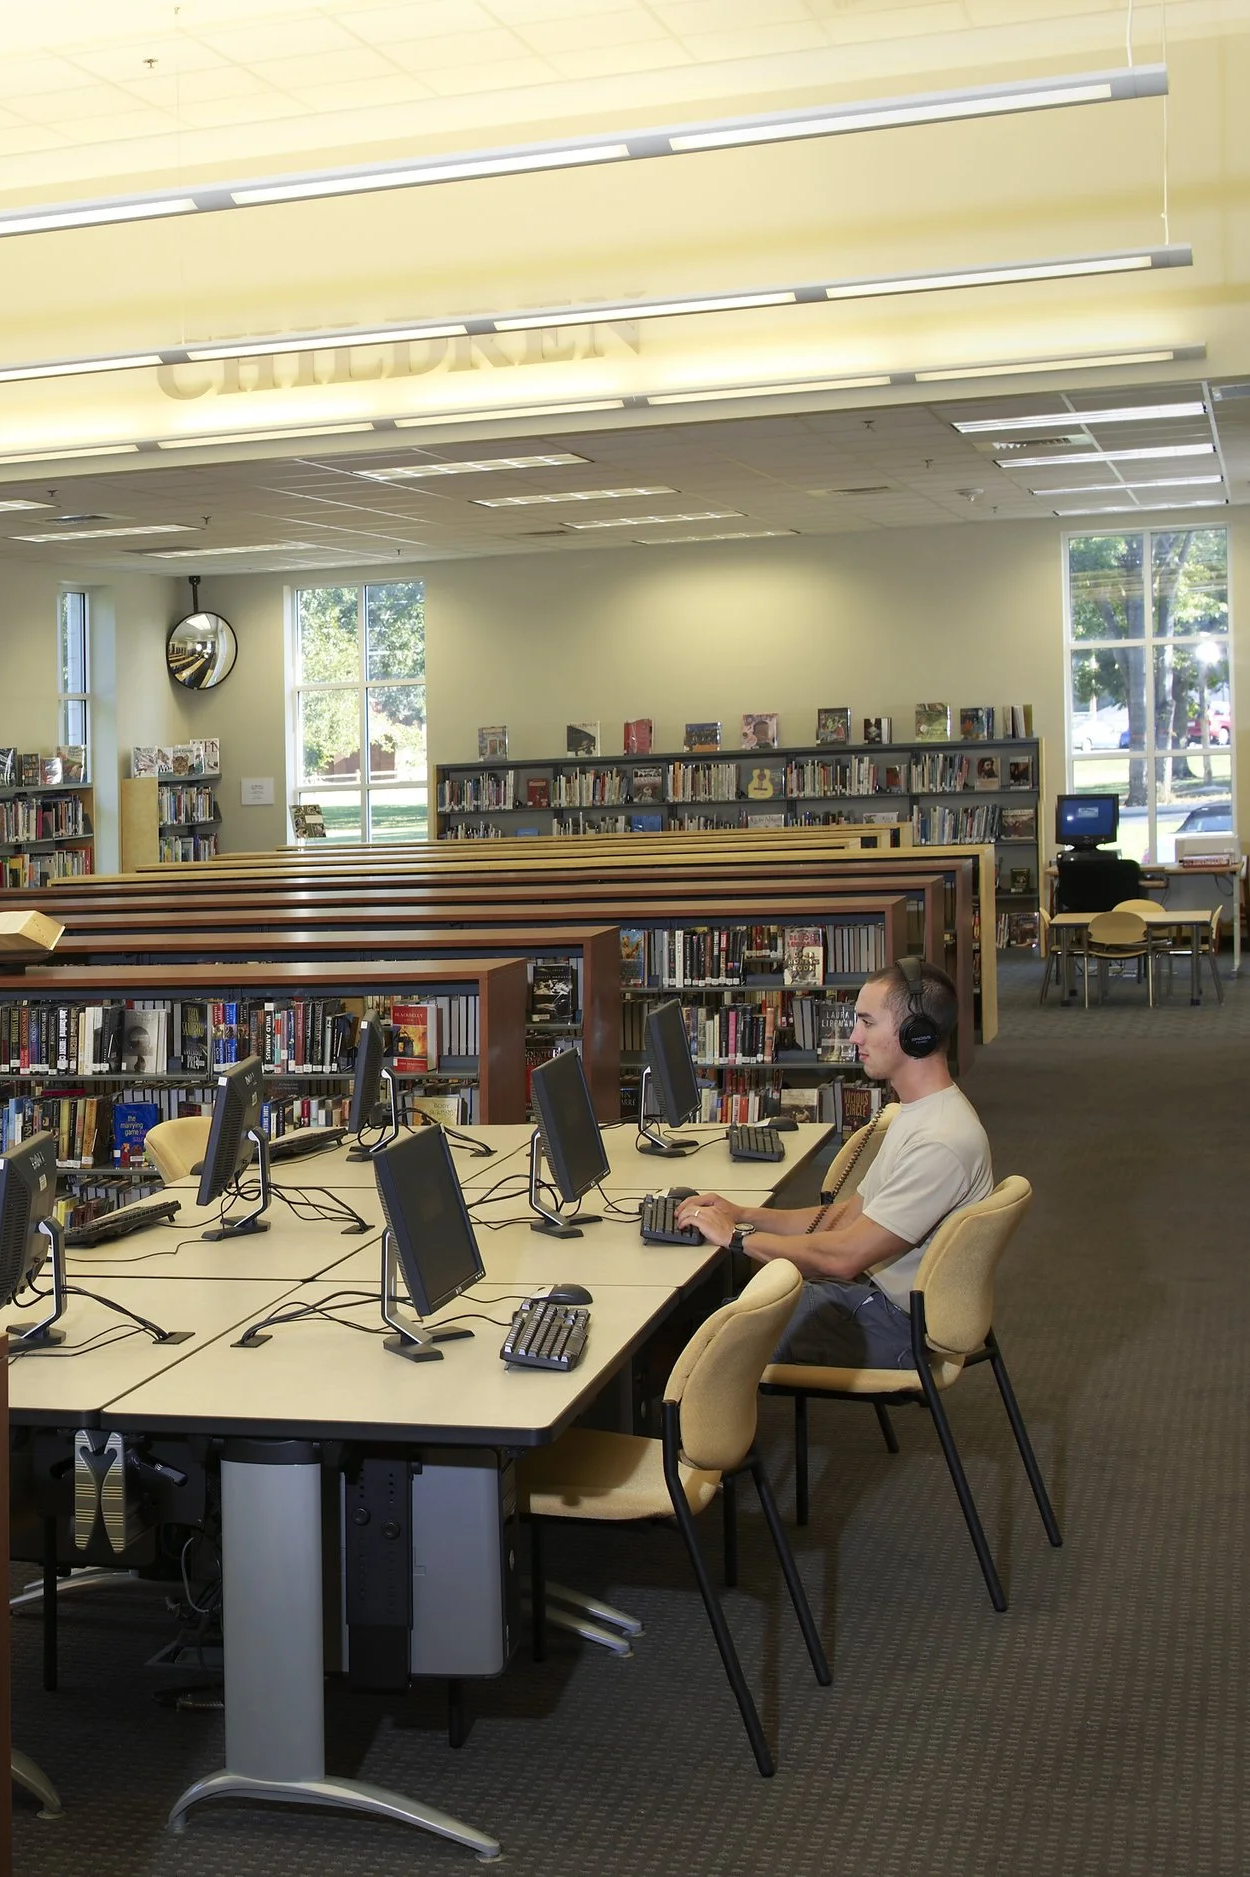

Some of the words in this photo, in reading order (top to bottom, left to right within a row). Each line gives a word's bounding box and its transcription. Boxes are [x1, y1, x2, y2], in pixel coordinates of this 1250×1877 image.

[156, 290, 648, 401] CHILDREN
[826, 1011, 850, 1019] LAURA
[844, 1090, 870, 1106] VICIOUS
[120, 1122, 144, 1130] marrying
[124, 1129, 140, 1137] game
